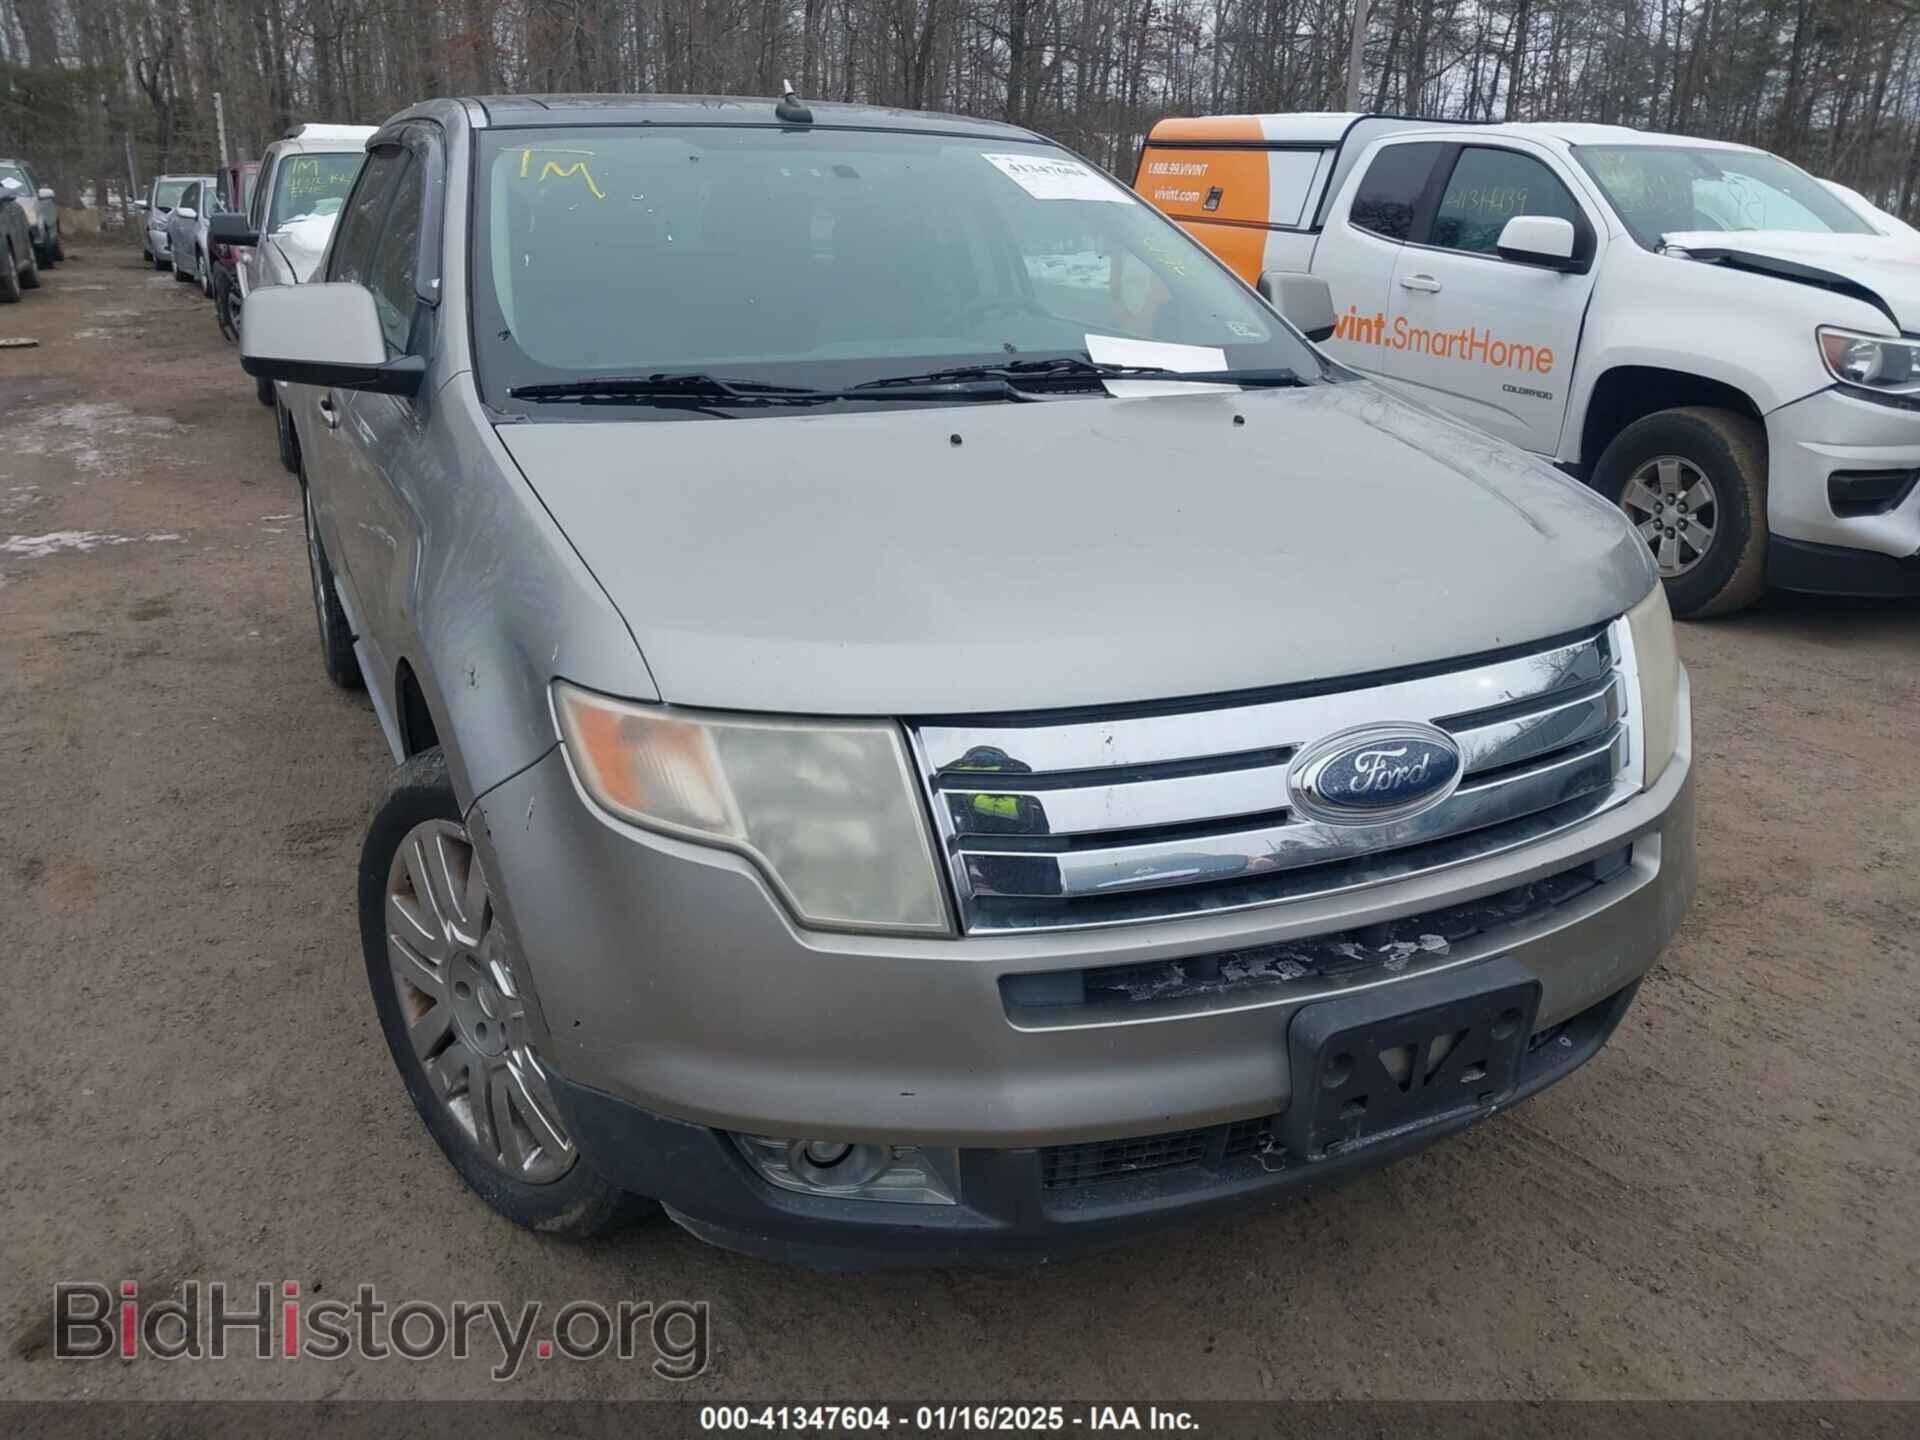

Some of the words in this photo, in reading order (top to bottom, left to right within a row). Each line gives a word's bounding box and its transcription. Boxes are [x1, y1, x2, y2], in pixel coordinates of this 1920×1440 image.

[1154, 186, 1200, 202] vivint.com
[1502, 383, 1553, 400] COLORADO
[1349, 747, 1431, 792] Ford
